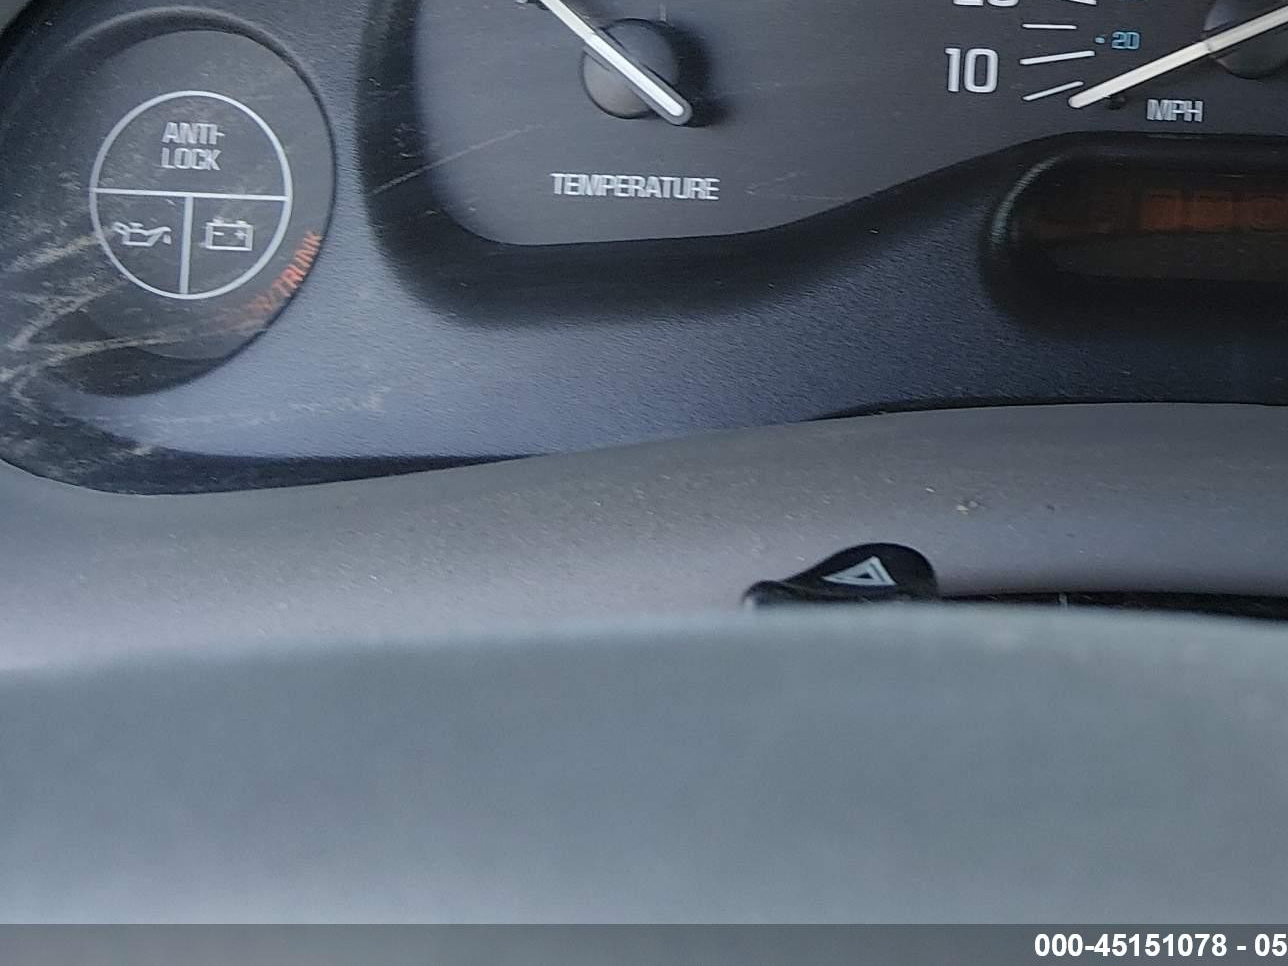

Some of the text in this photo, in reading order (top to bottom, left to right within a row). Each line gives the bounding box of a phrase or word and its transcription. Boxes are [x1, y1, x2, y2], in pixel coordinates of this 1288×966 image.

[1112, 31, 1140, 49] 20
[945, 48, 998, 93] 10
[1147, 99, 1202, 122] MPH
[162, 122, 225, 145] ANTI-
[161, 148, 221, 171] LOCK
[552, 173, 720, 201] TEMPERATURE
